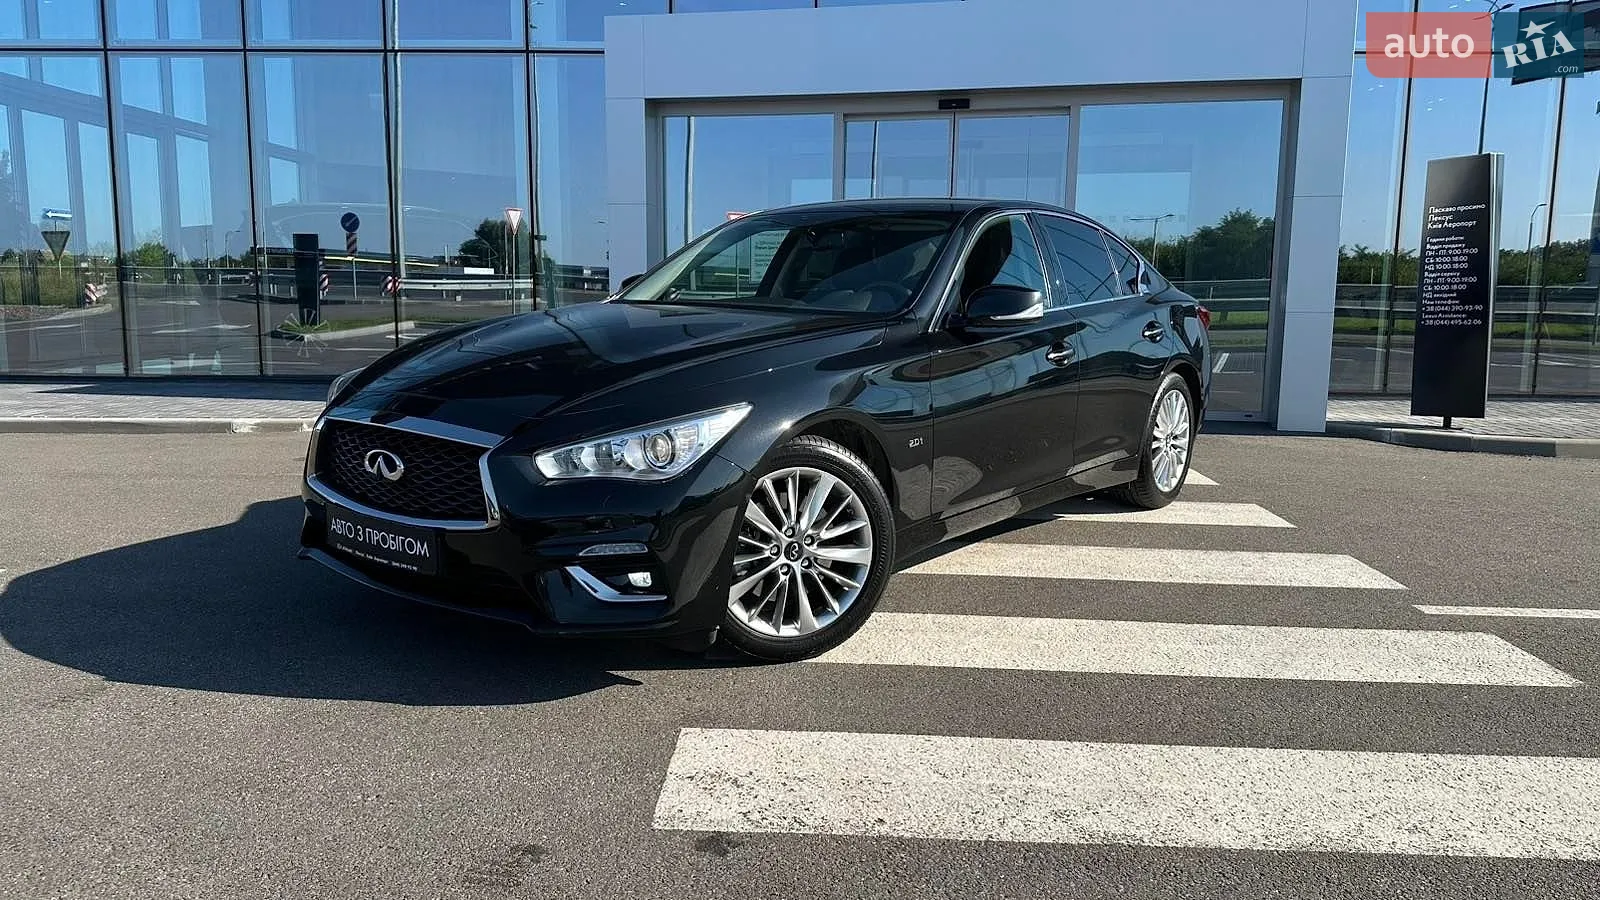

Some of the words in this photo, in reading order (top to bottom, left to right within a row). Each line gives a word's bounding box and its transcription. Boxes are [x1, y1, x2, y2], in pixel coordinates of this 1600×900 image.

[1442, 220, 1477, 228] Аеропорт
[331, 516, 355, 539] АВТО
[365, 528, 430, 558] ПРОБІГОМ
